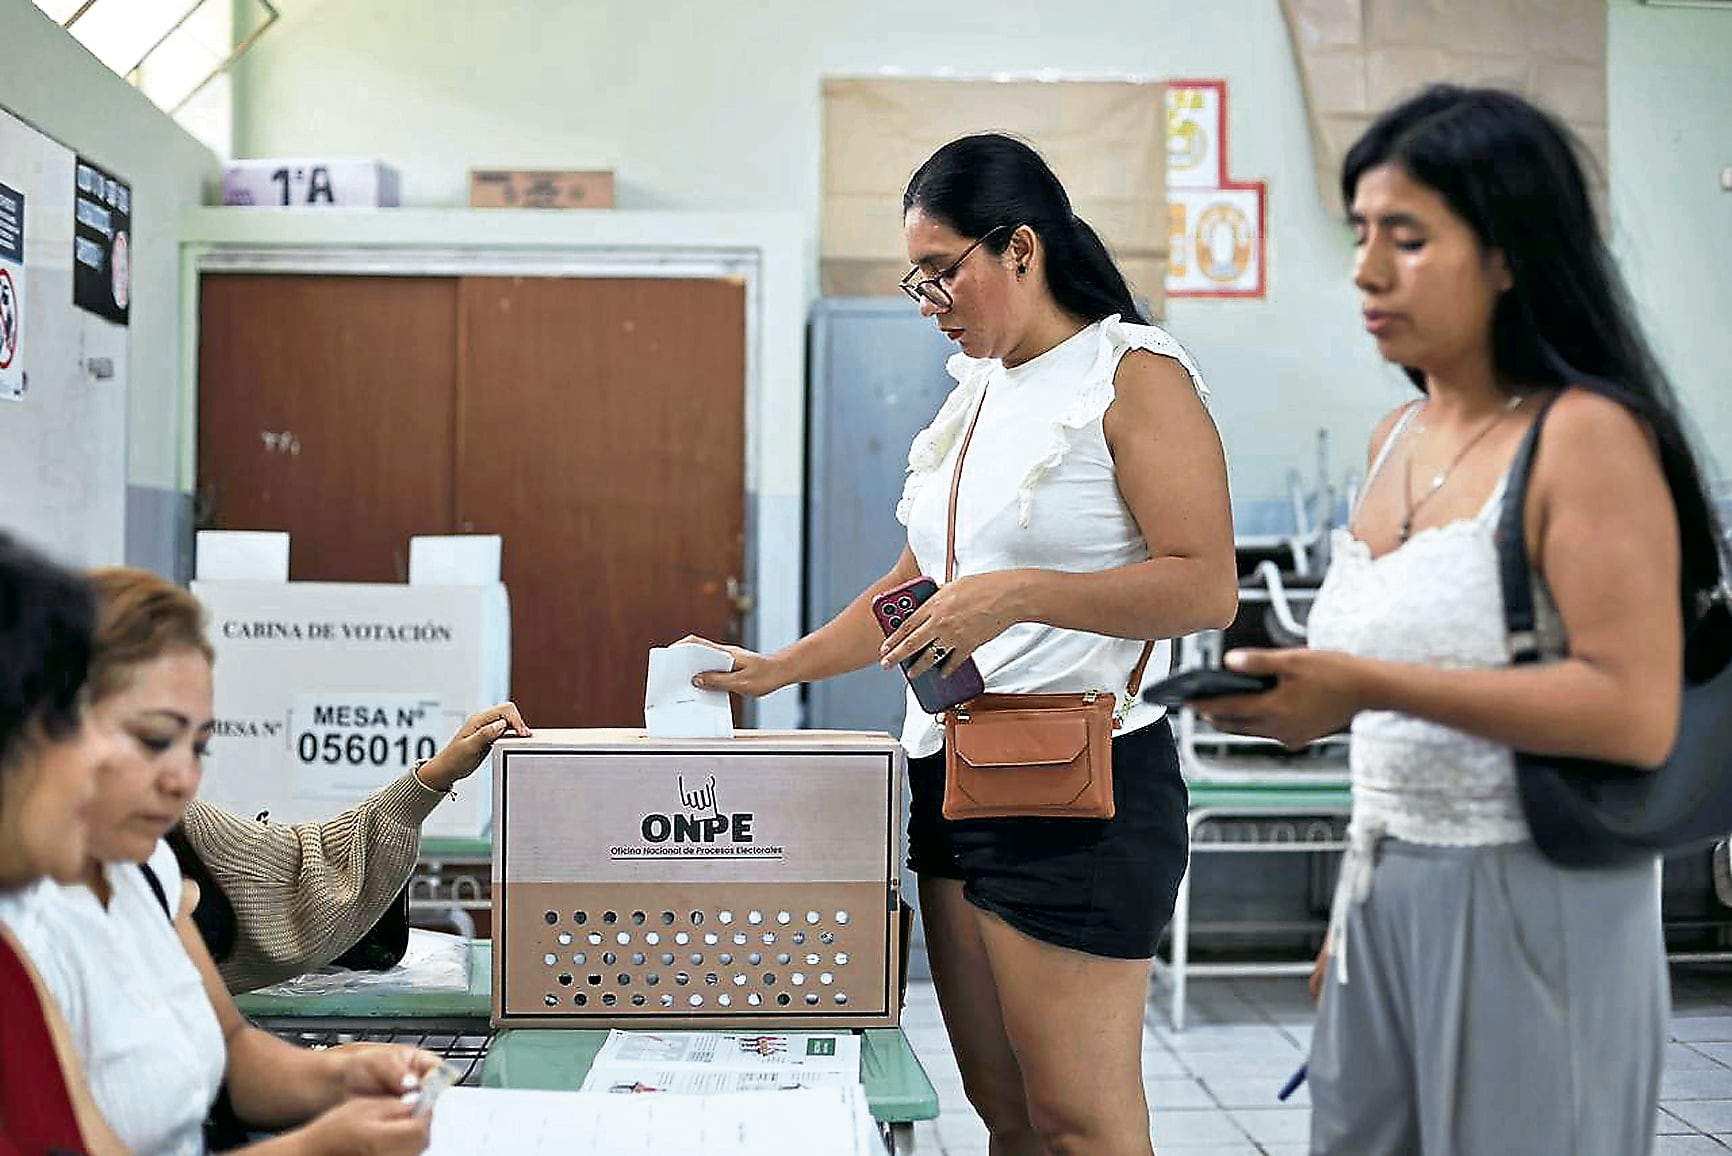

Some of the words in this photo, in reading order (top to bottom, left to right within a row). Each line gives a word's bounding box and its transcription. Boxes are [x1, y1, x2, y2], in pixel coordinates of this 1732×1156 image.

[223, 621, 302, 639] CABINA
[308, 622, 333, 640] DE
[341, 619, 451, 642] VOTACIÓN
[314, 705, 388, 727] MESA
[299, 732, 436, 766] 056010
[641, 813, 753, 843] ONPE
[611, 846, 641, 855] Oficina
[643, 846, 681, 855] Nacional
[683, 846, 694, 855] de
[696, 846, 733, 855] Procesos
[736, 846, 782, 855] Electorales
